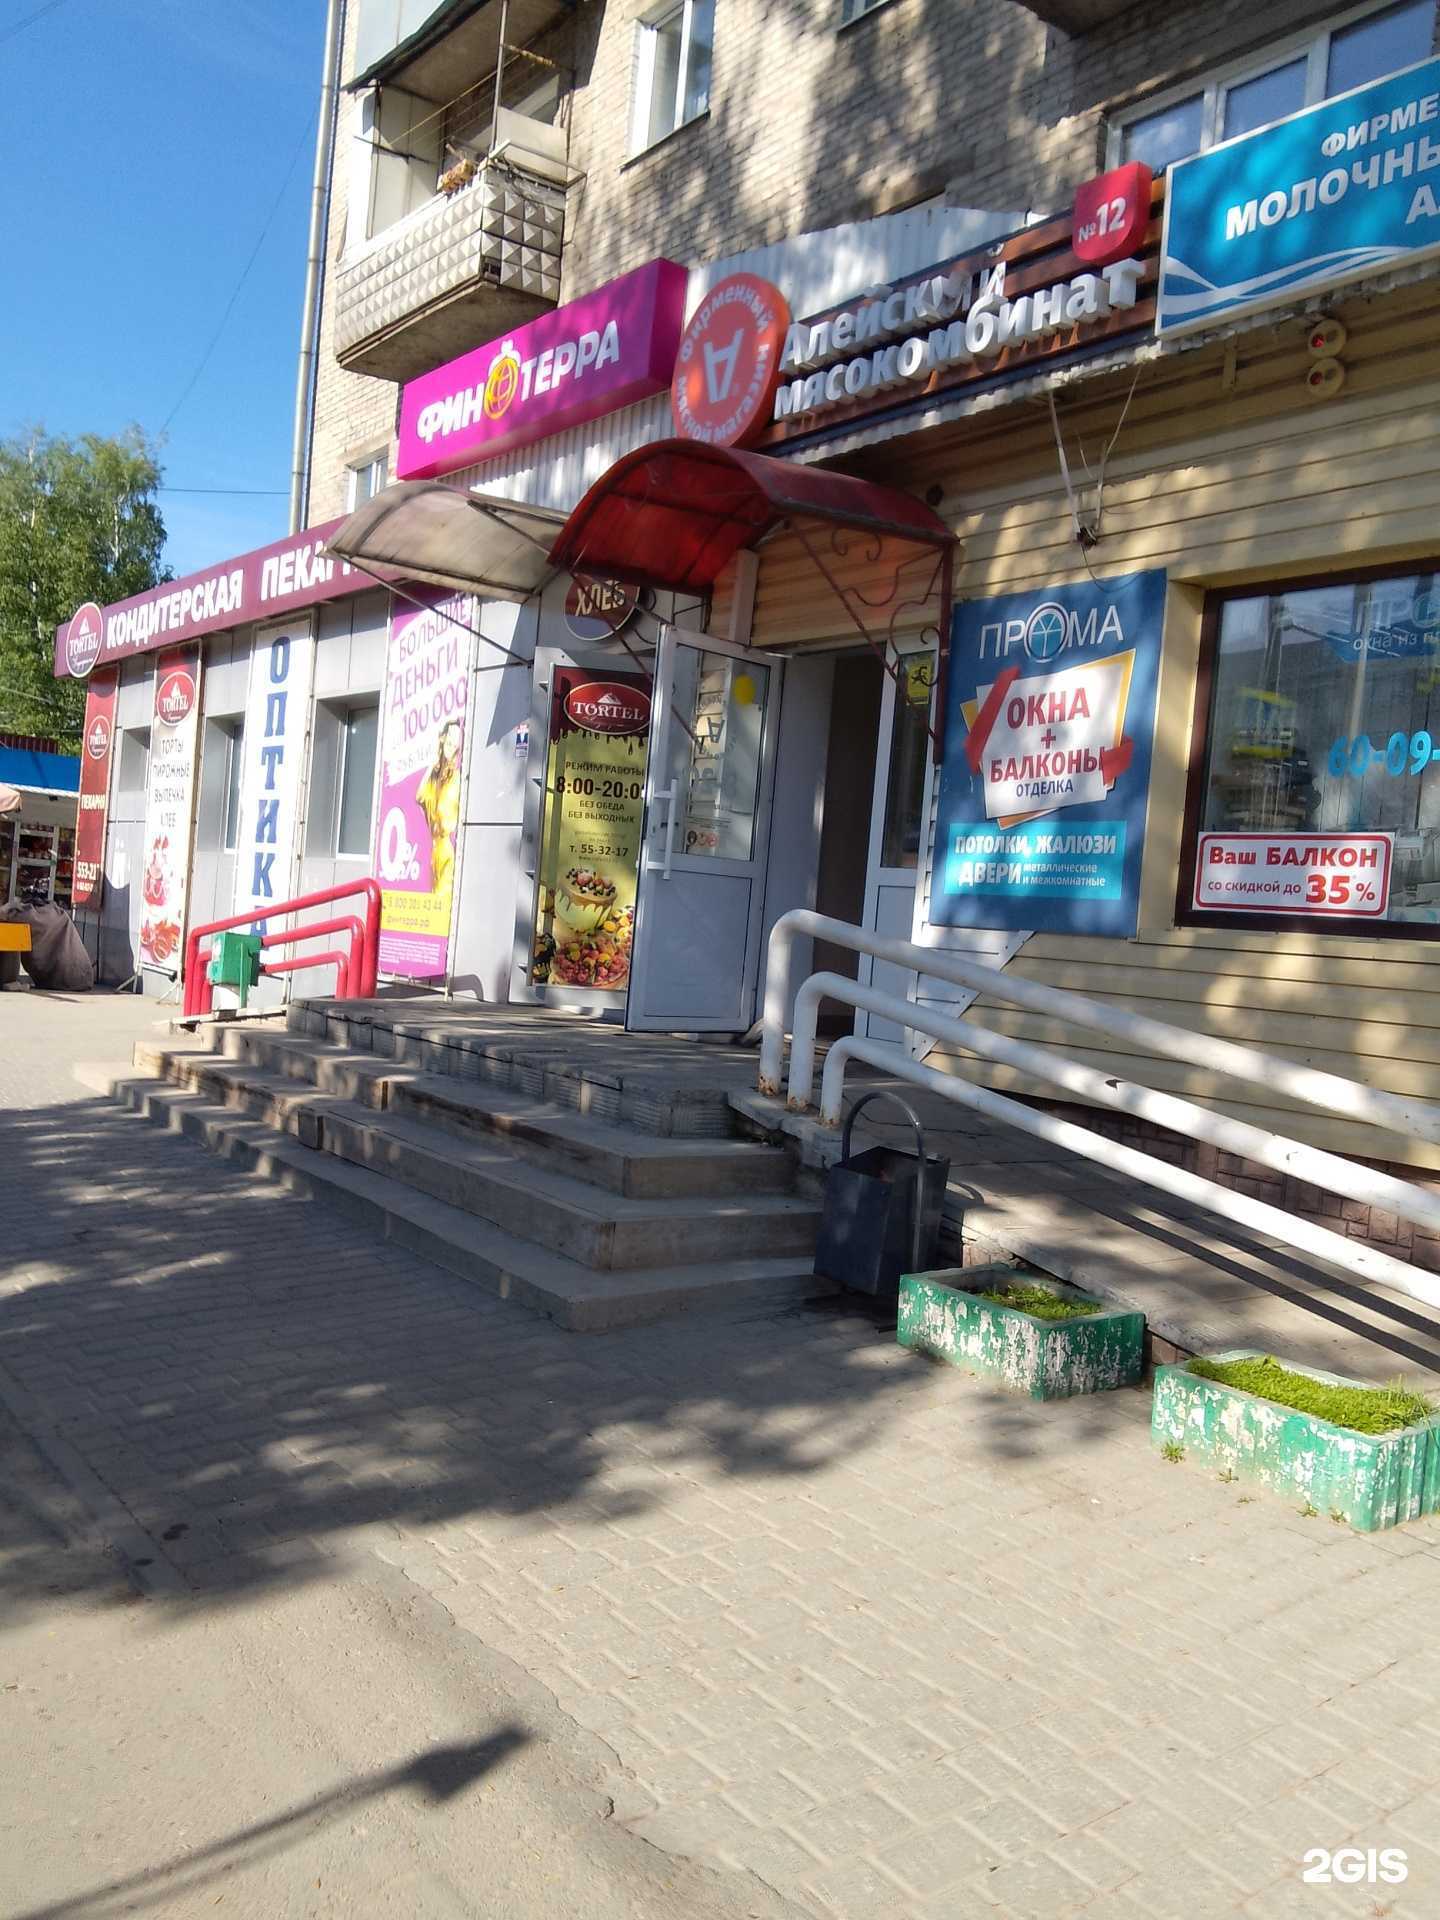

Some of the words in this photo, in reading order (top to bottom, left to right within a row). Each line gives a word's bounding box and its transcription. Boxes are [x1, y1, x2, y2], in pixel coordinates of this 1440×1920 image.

[1321, 92, 1440, 158] ФИРМЕ
[1405, 184, 1440, 224] А
[774, 258, 1146, 421] мясокомбинат
[106, 569, 244, 649] КОНДИТЕРСКАЯ
[260, 540, 358, 601] ПЕКА
[399, 601, 467, 663] БОЛЬШИЕ
[391, 637, 458, 715] ДЕНЬГИ
[402, 704, 429, 742] 100
[432, 677, 468, 723] 000
[572, 701, 647, 721] TORTEL
[1006, 687, 1090, 729] ОКНА
[990, 746, 1106, 783] БАЛКОНЫ
[556, 775, 645, 800] 8:00-20:0
[1015, 778, 1074, 798] ОТДЕЛКА
[580, 844, 629, 857] 55-32-17
[1035, 835, 1117, 855] ЖАЛЮЗИ
[1209, 846, 1257, 865] Ваш
[1265, 847, 1378, 868] БАЛКОН
[958, 862, 1023, 888] ДВЕРИ
[1023, 863, 1098, 873] металлические
[1030, 876, 1106, 887] межкомнатные
[1208, 880, 1222, 890] со
[1225, 880, 1281, 894] скидкой
[1283, 884, 1302, 895] до
